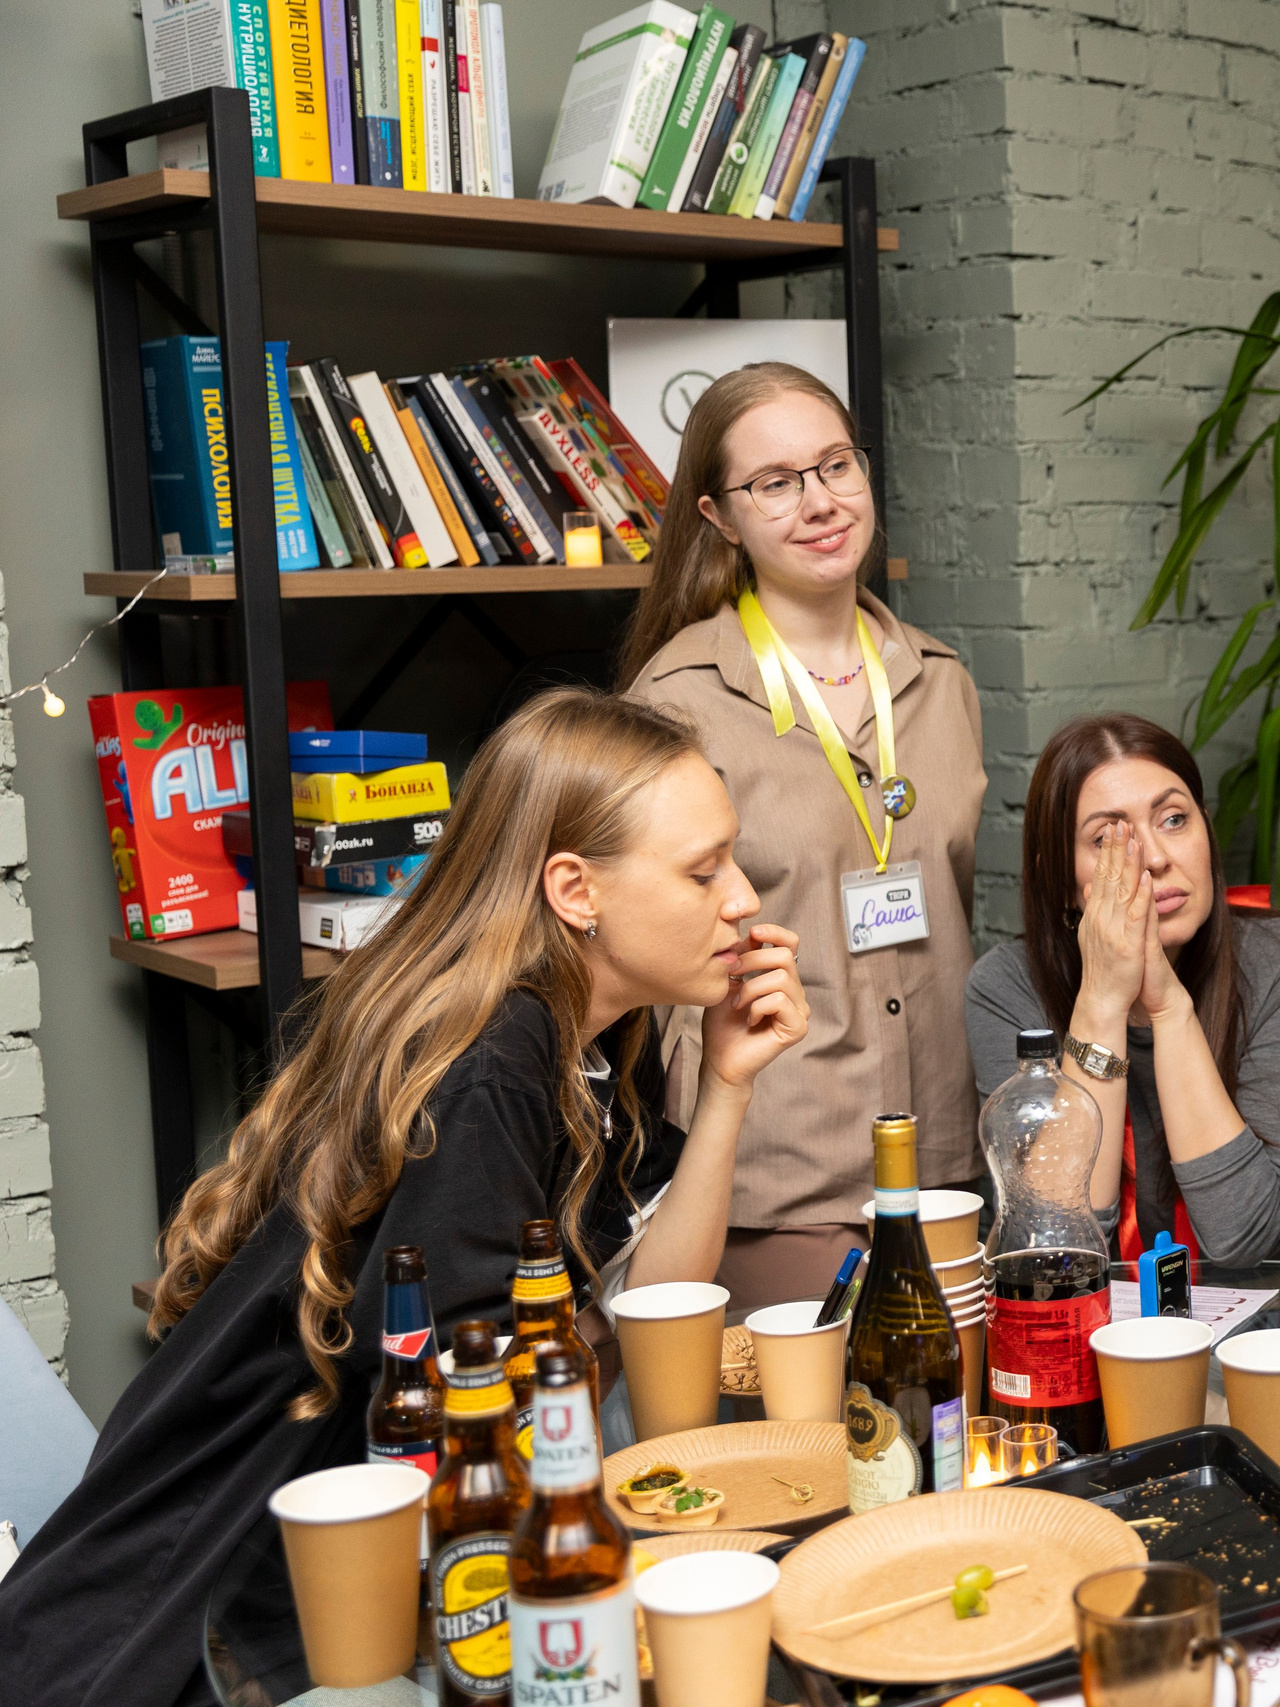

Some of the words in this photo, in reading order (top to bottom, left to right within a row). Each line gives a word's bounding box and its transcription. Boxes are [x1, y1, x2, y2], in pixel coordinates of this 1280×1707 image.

[237, 3, 263, 137] НУТРИЦИОЛОГИЯ
[253, 5, 273, 138] СПОРТИВНАЯ
[377, 43, 389, 110] Философский
[449, 36, 457, 83] ЖЕНЩИНА,
[676, 19, 726, 130] НУТРИЦИОЛОГИЯ
[431, 79, 439, 130] РАЗРЕШАЮ
[451, 90, 459, 132] КОТОРОЙ
[434, 159, 442, 185] ЖИТЬ
[202, 388, 233, 529] ПСИХОЛОГИЯ
[538, 411, 600, 493] ДУХLESS
[272, 467, 302, 527] ШУТКА
[187, 720, 245, 751] Origin
[151, 739, 249, 820] ALI
[193, 815, 224, 831] СКАЖ
[413, 821, 443, 840] 500
[168, 873, 194, 889] 2400
[168, 887, 185, 897] слов
[185, 884, 199, 894] для
[862, 899, 922, 927] Саша
[533, 1267, 553, 1276] SEMI
[383, 1334, 406, 1351] ud
[1074, 1307, 1084, 1395] ПЕРЕРАБАТЫВАЕМАЯ
[848, 1415, 874, 1432] 1689
[457, 1540, 510, 1558] PRESSED
[517, 1674, 621, 1707] SPATEN
